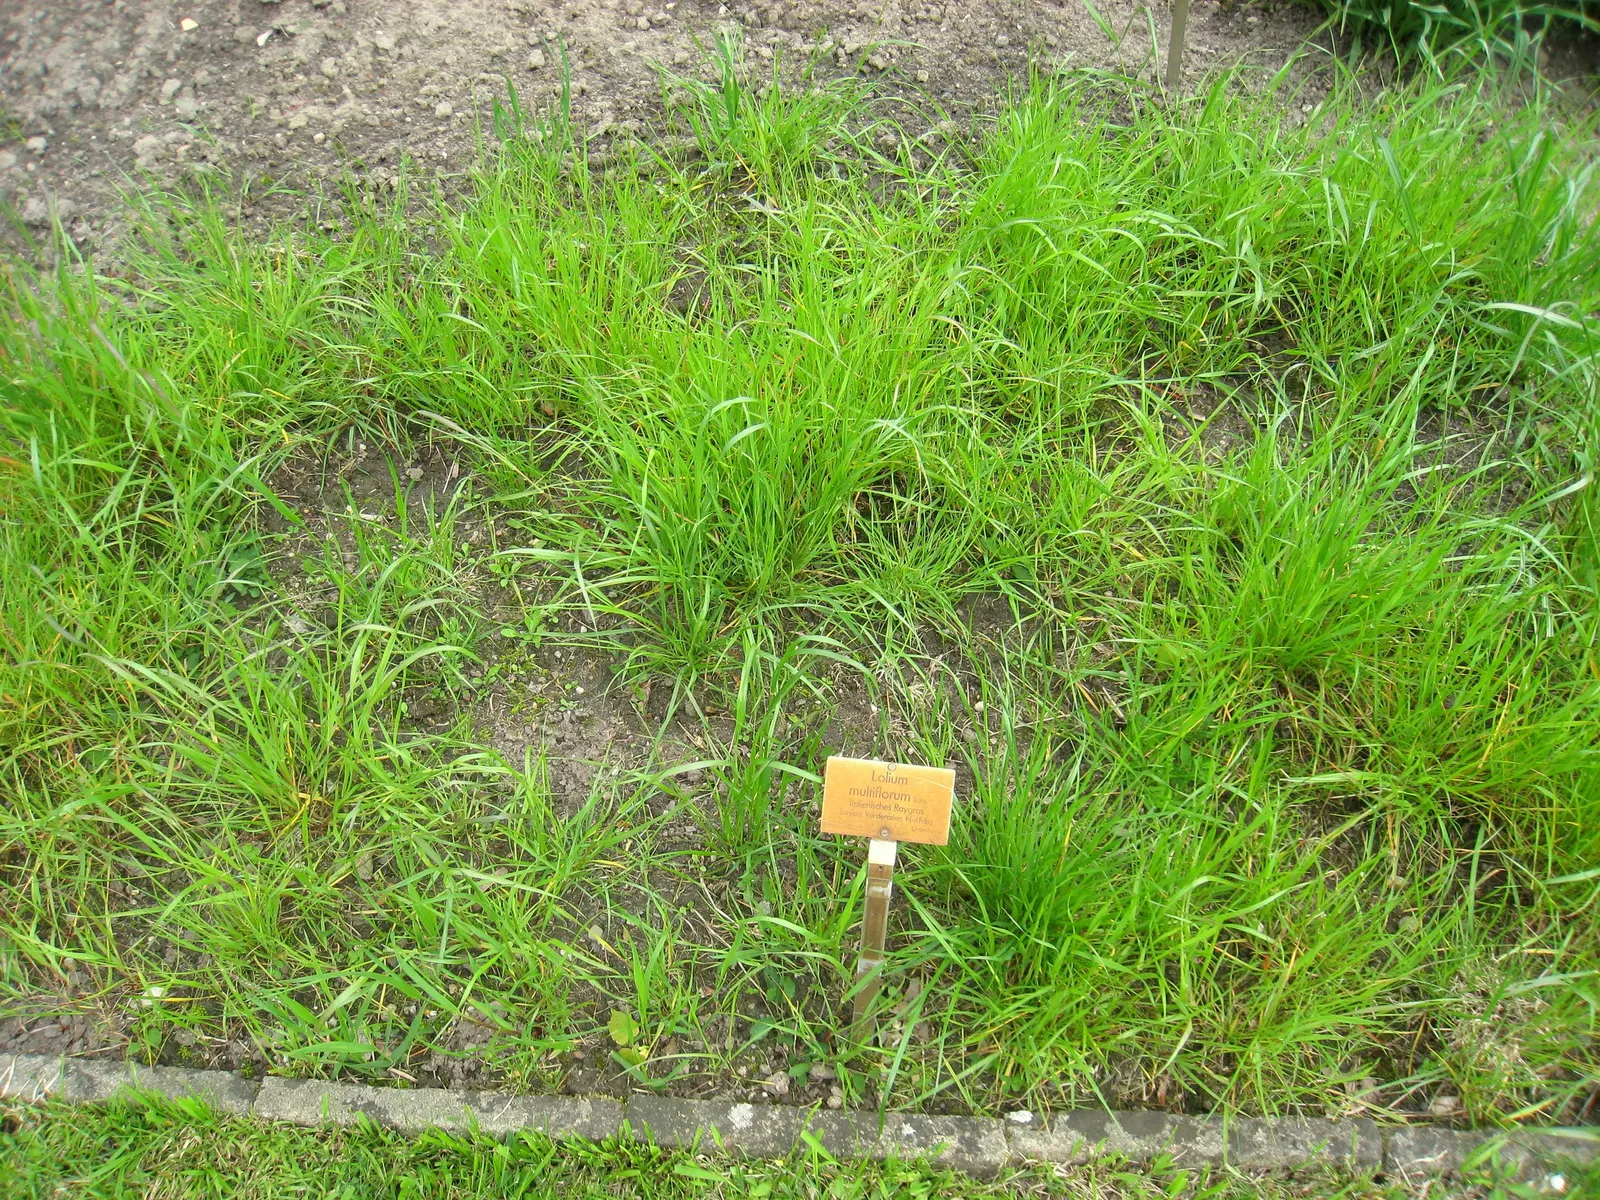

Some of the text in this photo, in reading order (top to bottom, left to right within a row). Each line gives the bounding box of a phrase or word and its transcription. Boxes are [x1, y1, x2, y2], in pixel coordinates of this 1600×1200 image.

[871, 770, 908, 785] Lolium
[849, 785, 911, 801] multiflorum
[849, 799, 925, 816] Italienisches Raygras
